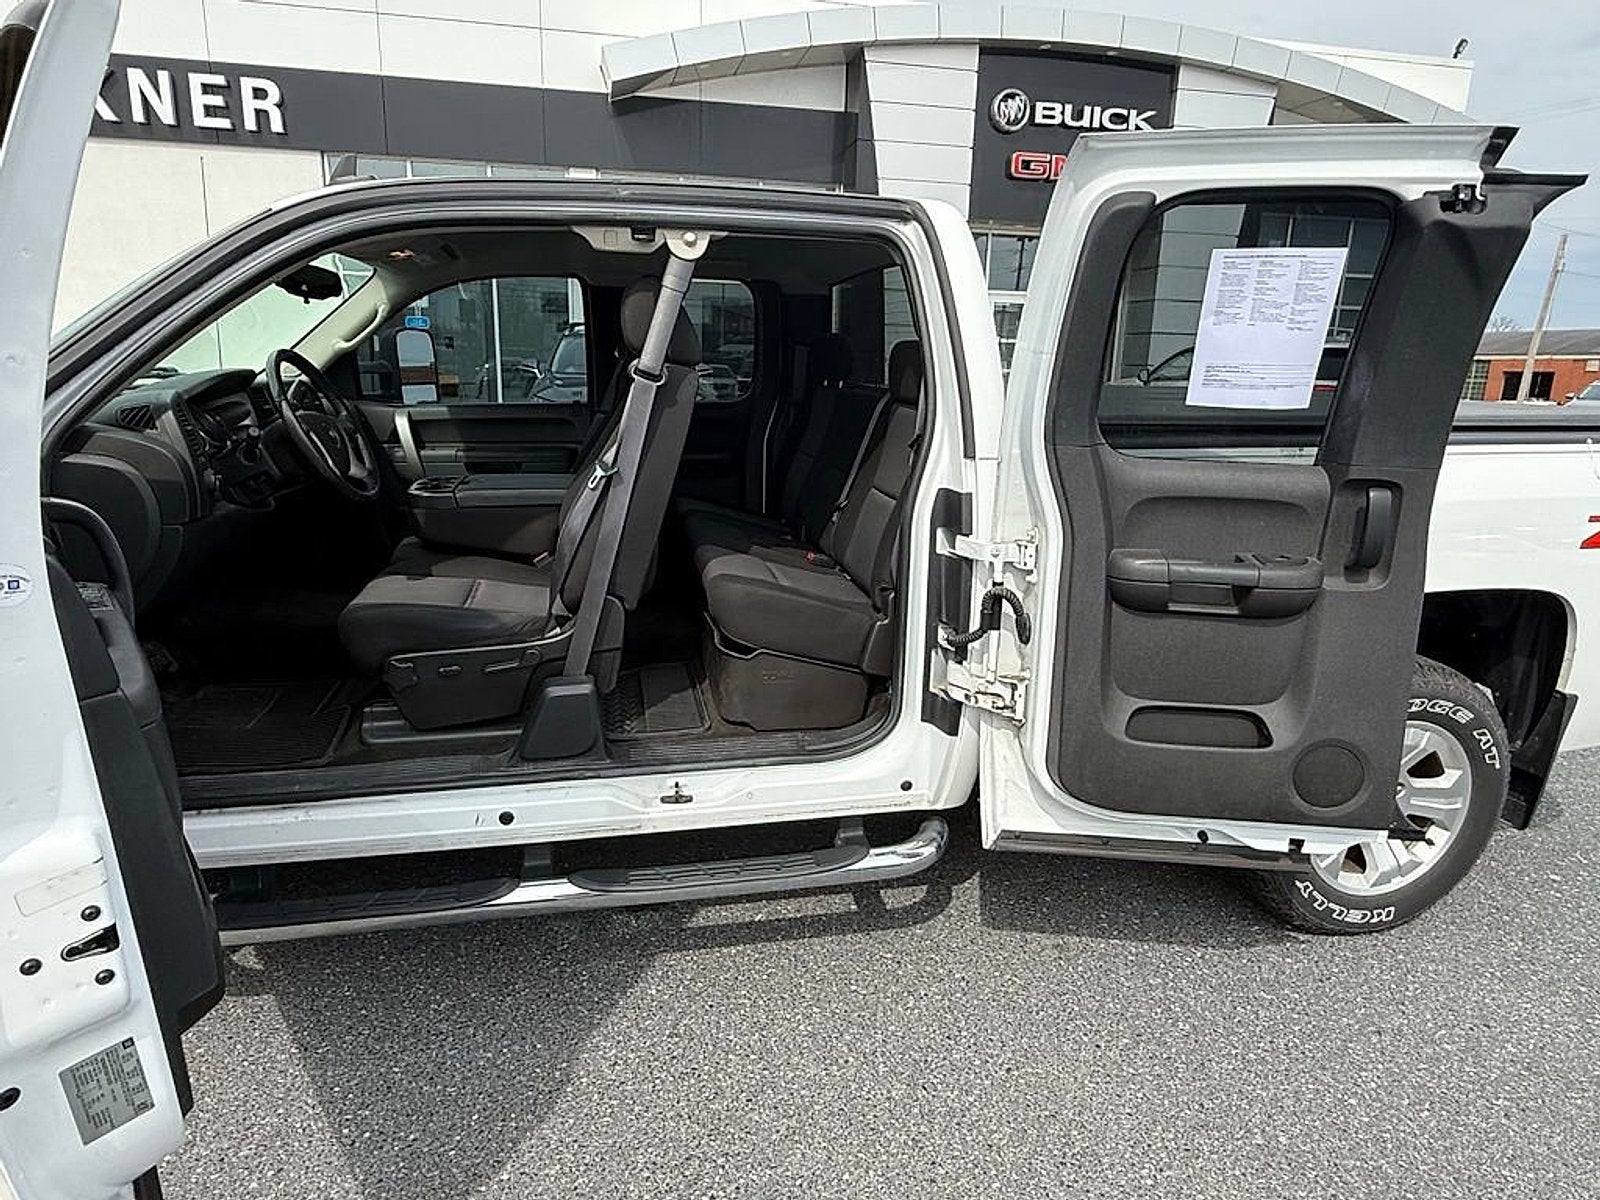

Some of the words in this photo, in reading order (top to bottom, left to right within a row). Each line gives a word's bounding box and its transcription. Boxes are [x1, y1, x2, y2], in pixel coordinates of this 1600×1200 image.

[1034, 101, 1157, 131] BUICK
[1473, 729, 1500, 769] AT
[1295, 880, 1395, 923] KELLY
